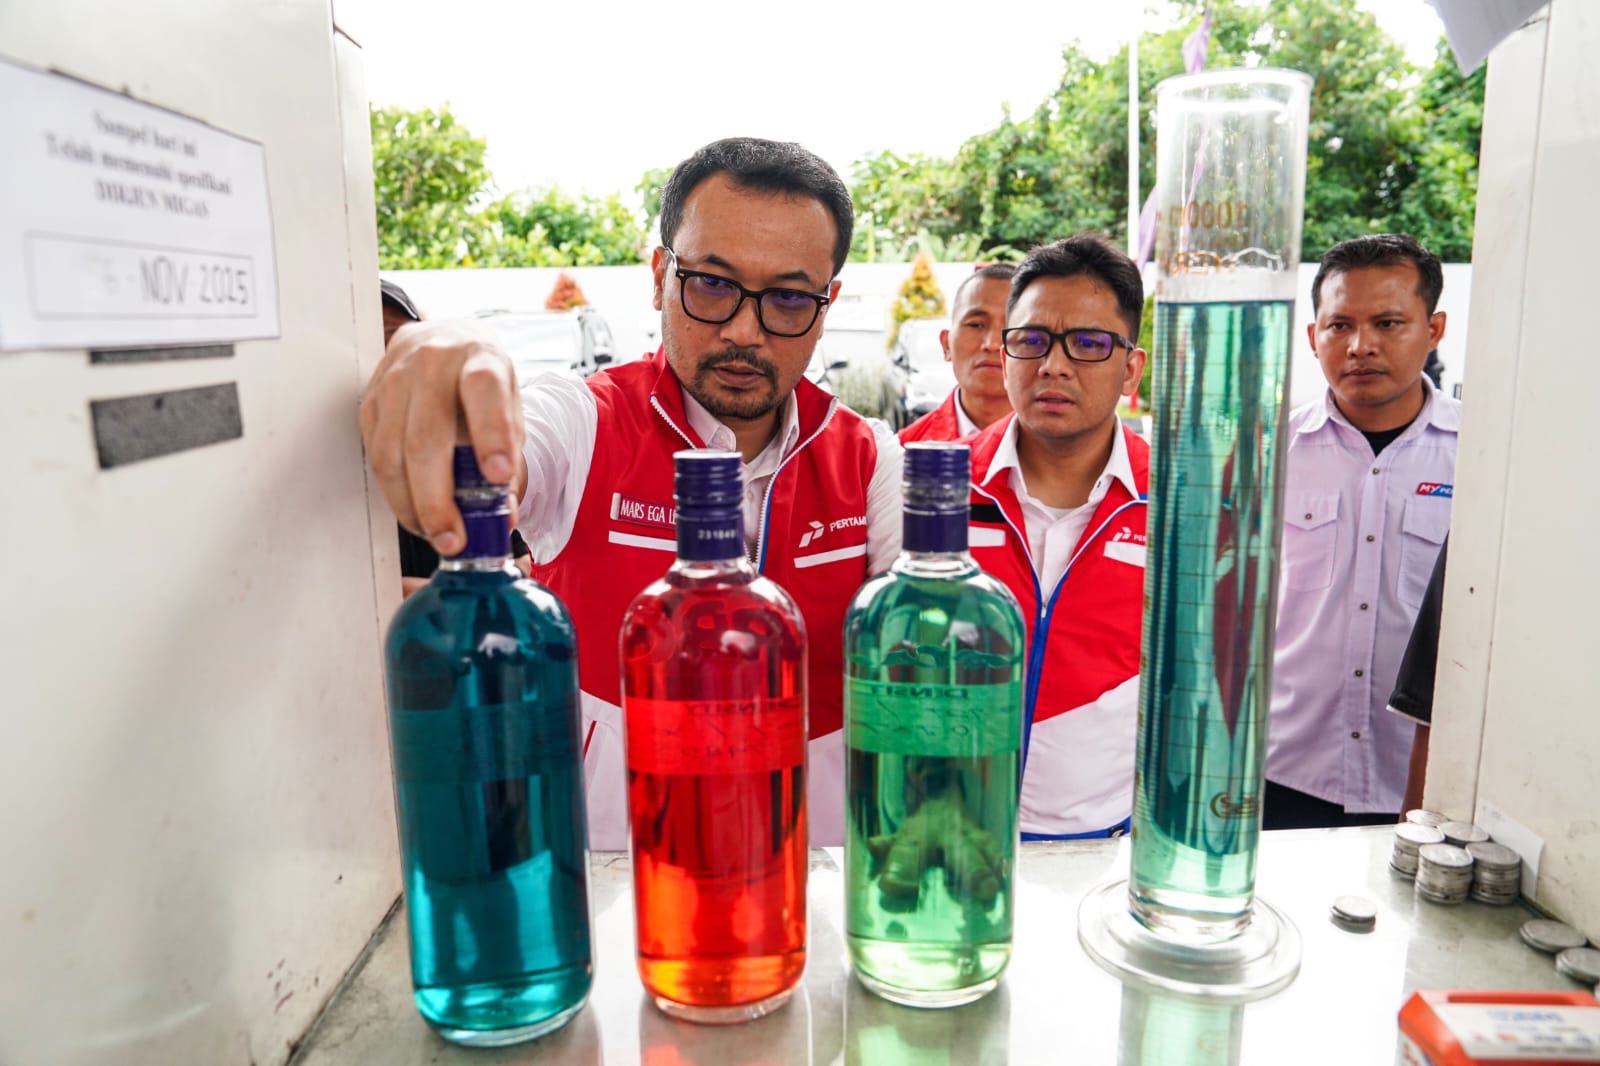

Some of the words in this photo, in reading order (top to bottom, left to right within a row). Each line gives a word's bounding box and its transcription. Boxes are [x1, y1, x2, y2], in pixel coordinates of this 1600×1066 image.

[139, 255, 189, 304] NOV
[199, 264, 248, 305] 2025
[620, 499, 645, 519] MARS
[647, 505, 665, 523] EGA
